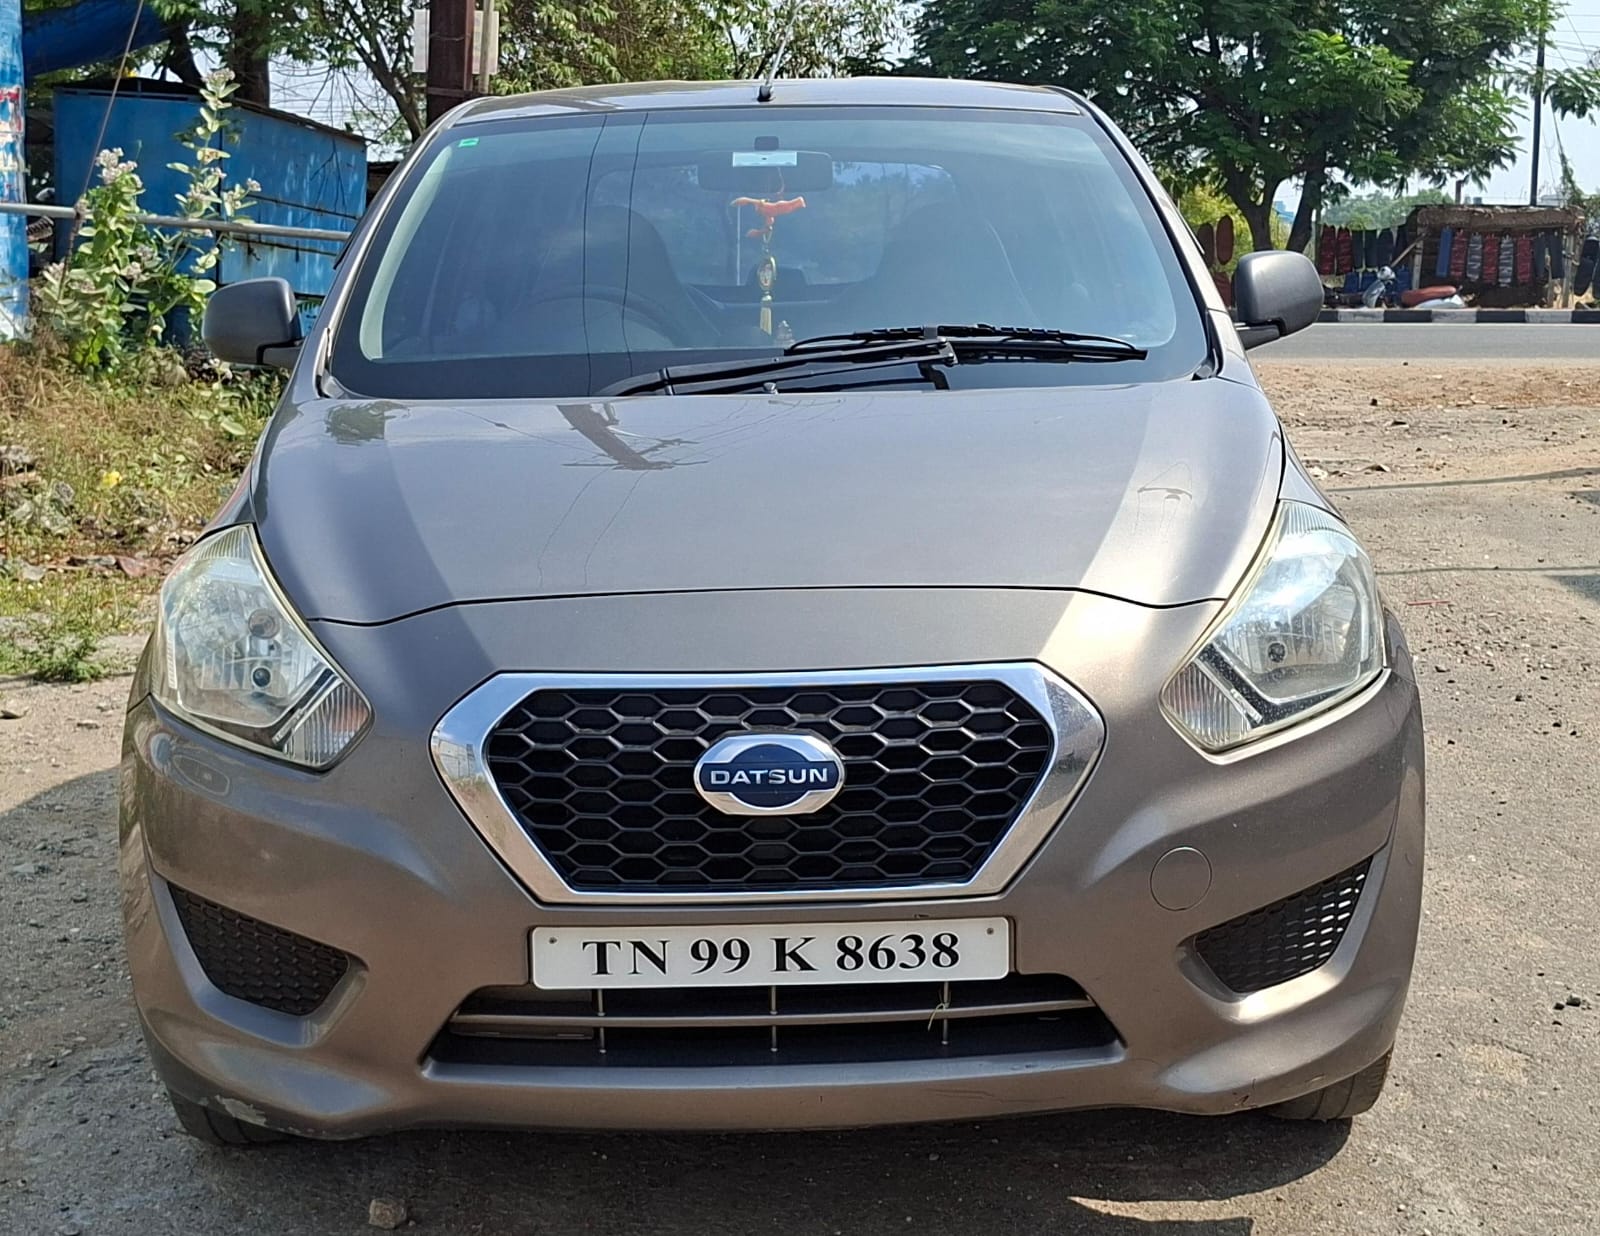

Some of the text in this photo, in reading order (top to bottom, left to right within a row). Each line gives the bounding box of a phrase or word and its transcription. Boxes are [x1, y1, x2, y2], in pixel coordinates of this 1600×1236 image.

[710, 768, 828, 785] DATSUN
[582, 932, 961, 976] TN 99 K 8638
